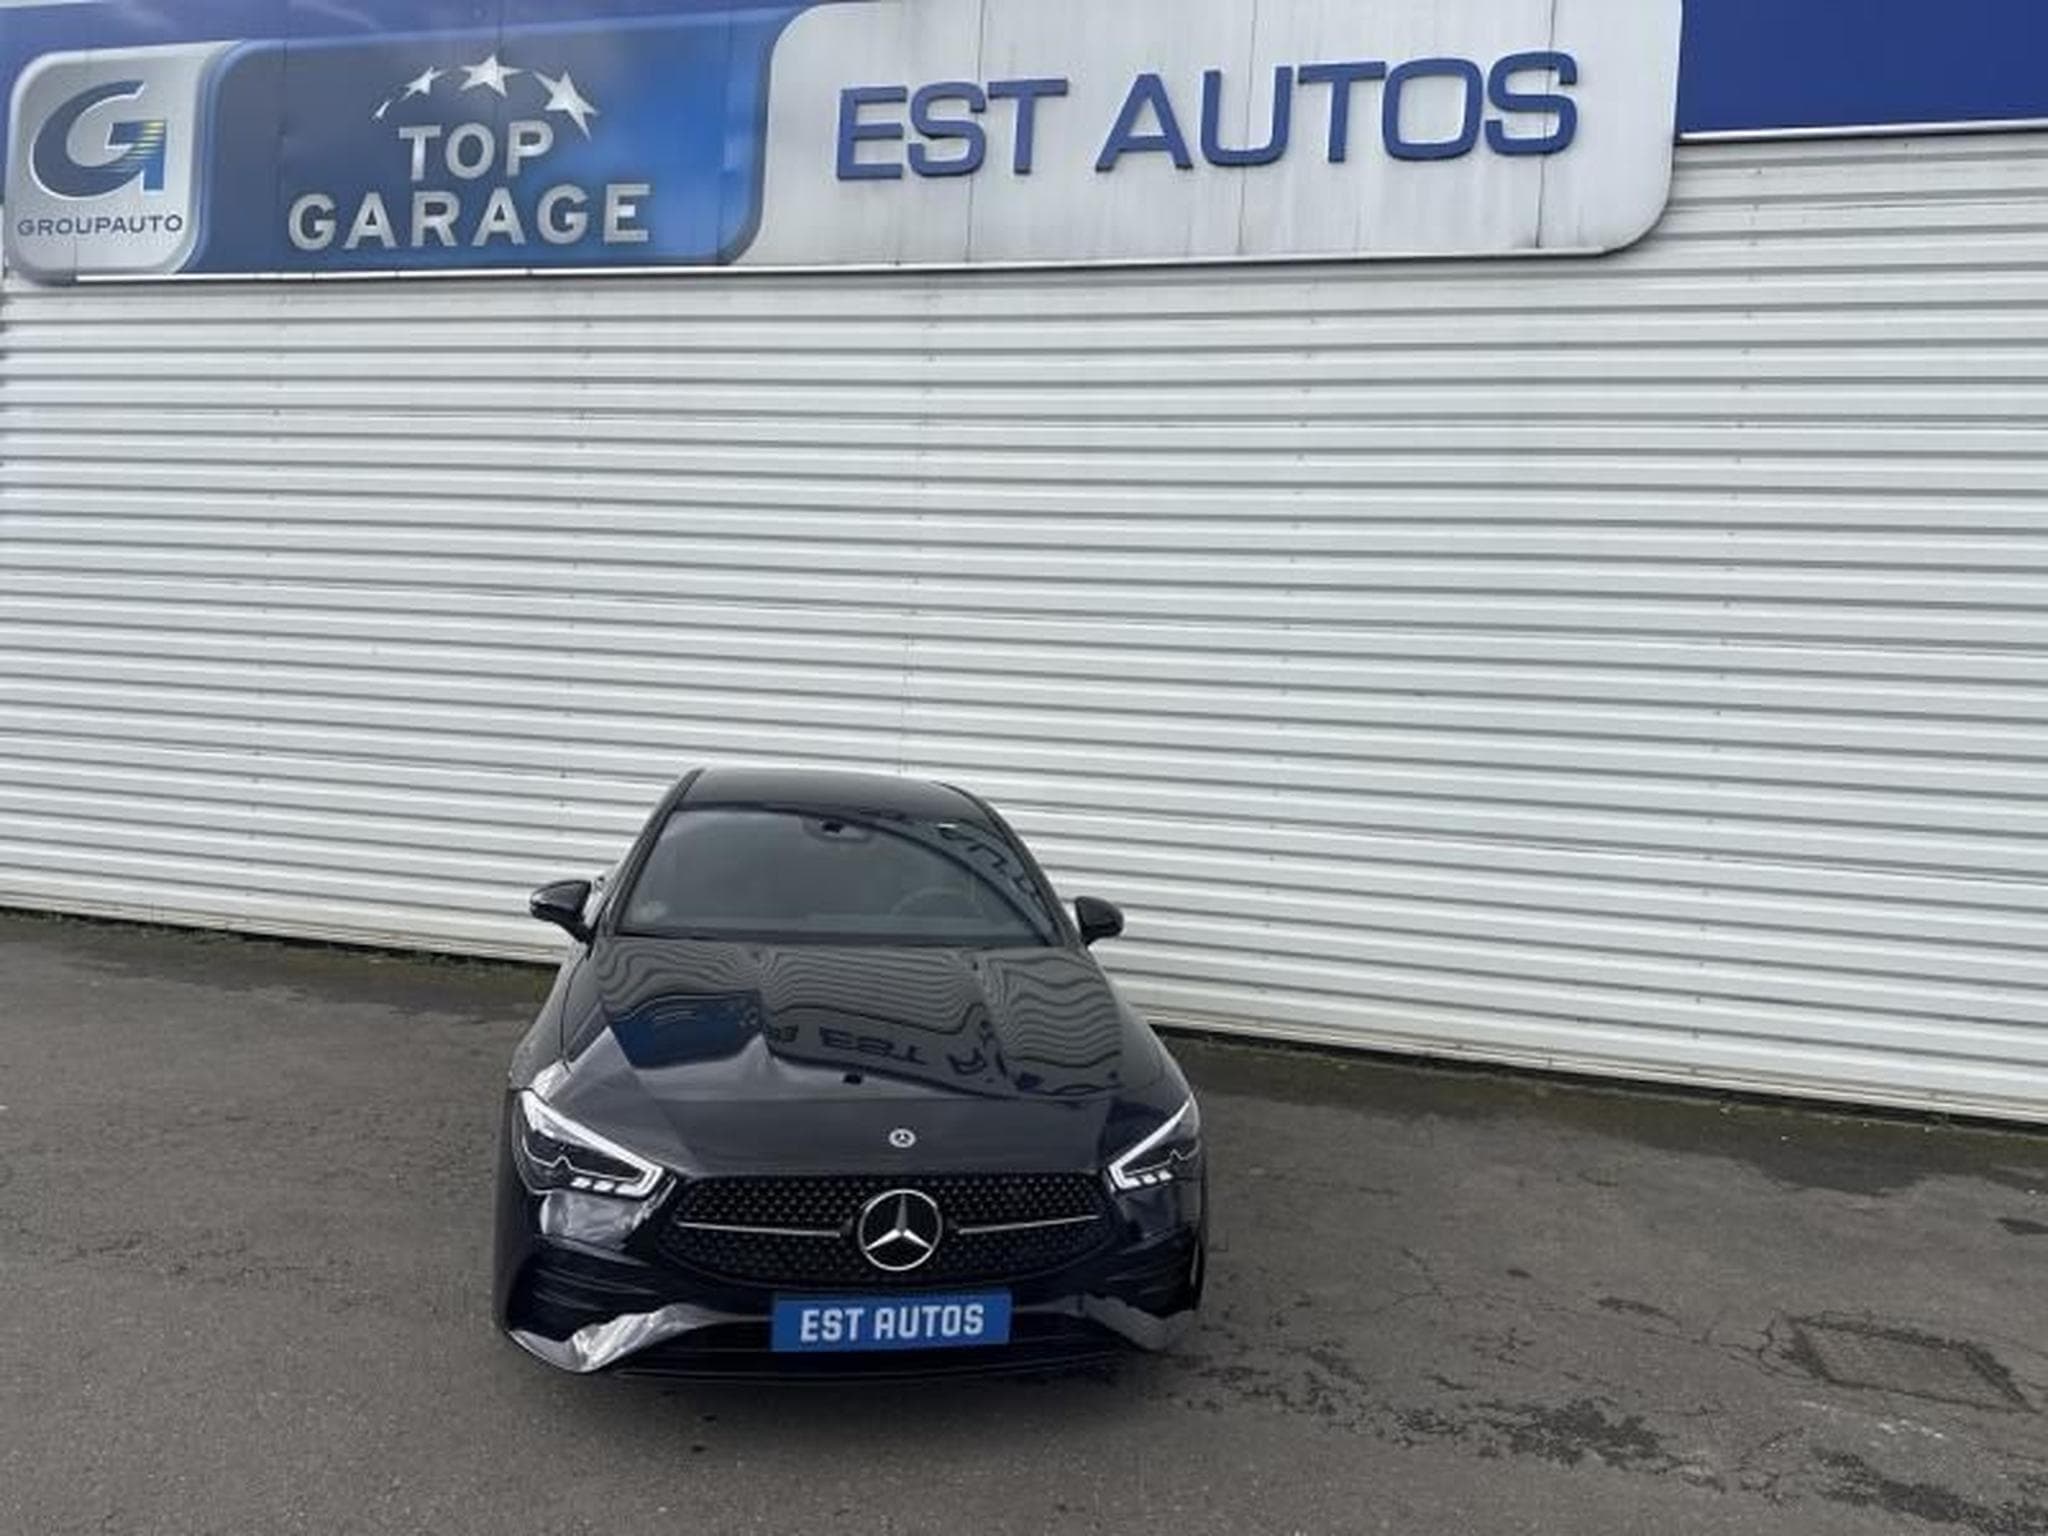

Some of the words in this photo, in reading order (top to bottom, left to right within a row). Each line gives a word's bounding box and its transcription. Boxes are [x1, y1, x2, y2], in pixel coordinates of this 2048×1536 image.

[836, 79, 1069, 180] EST
[1096, 51, 1579, 172] AUTOS
[399, 121, 554, 181] TOP
[17, 214, 183, 236] GROUPAUTO
[288, 184, 651, 251] GARAGE
[800, 1309, 864, 1342] EST
[874, 1304, 984, 1341] AUTOS
